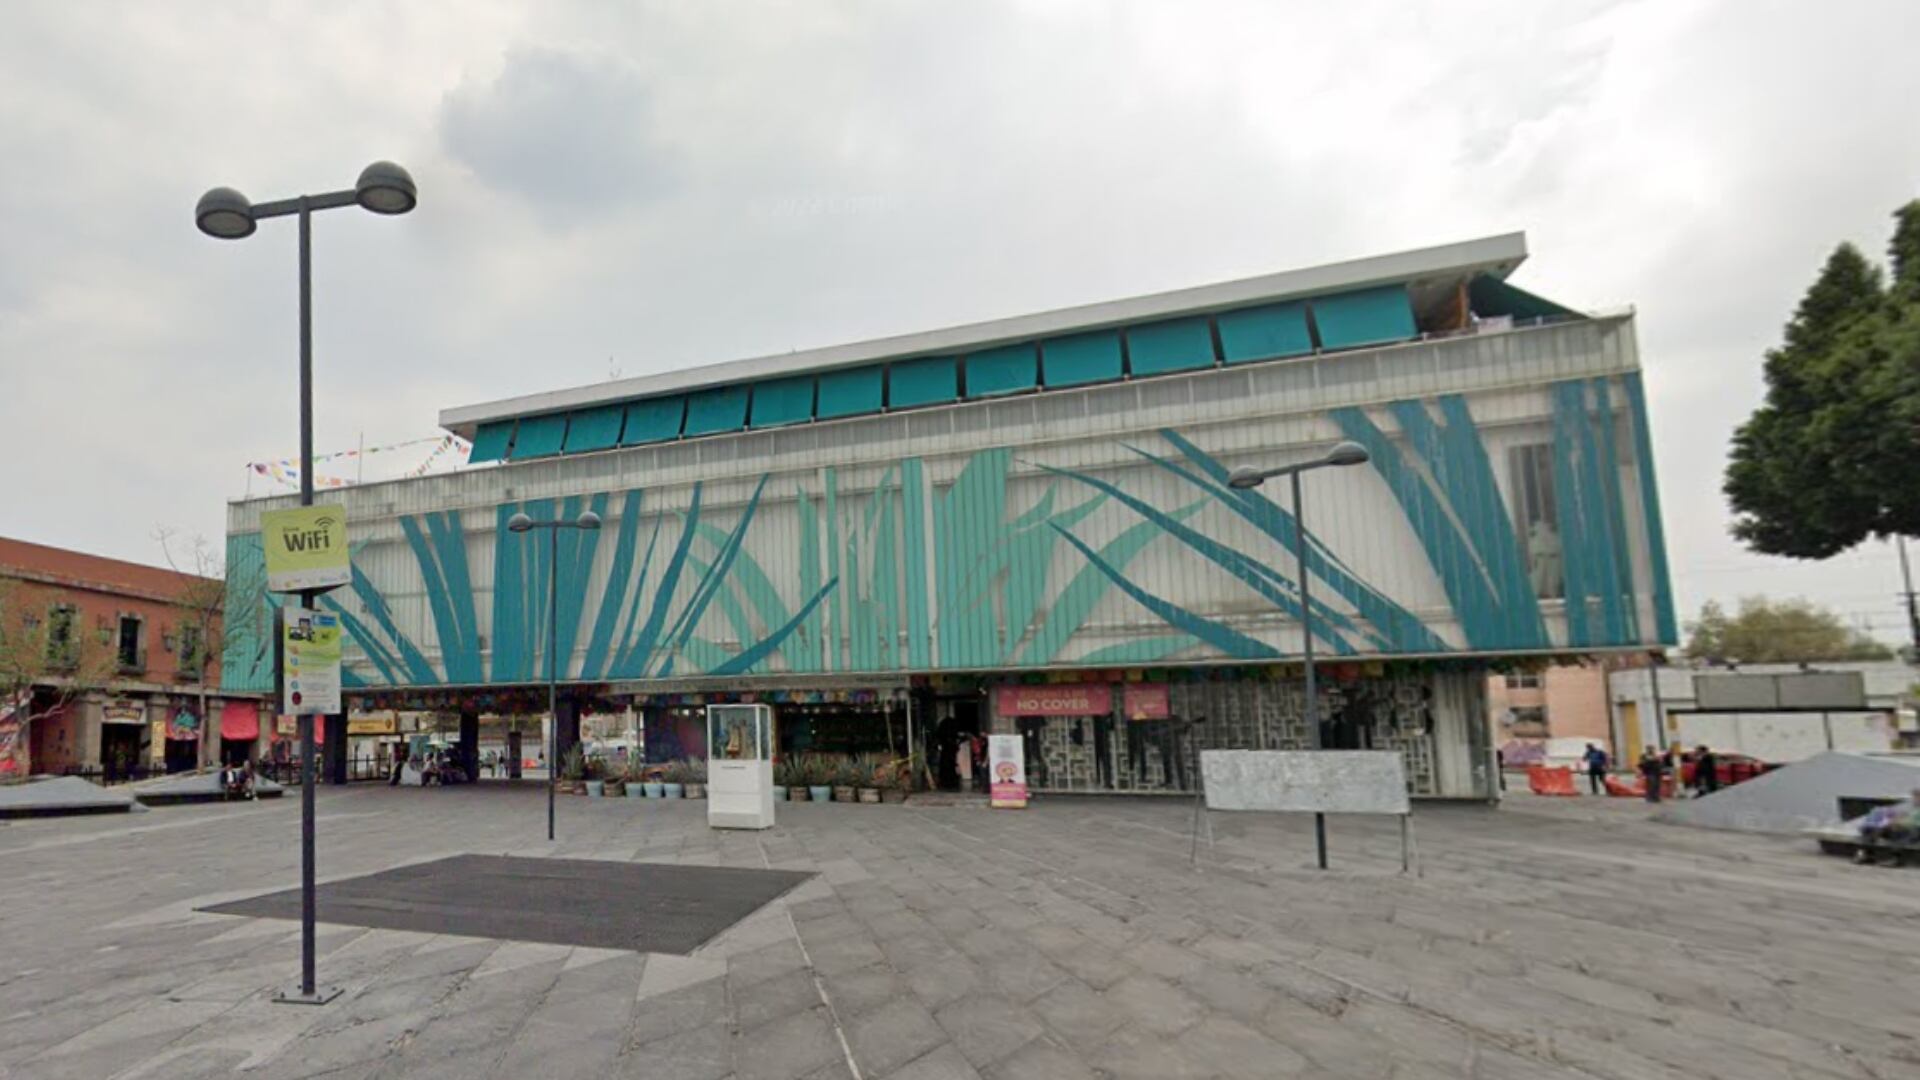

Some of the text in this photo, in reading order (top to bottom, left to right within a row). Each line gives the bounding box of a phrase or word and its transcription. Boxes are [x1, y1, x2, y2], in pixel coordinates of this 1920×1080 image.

[283, 529, 330, 552] WiFi
[1017, 698, 1089, 710] NO COVER
